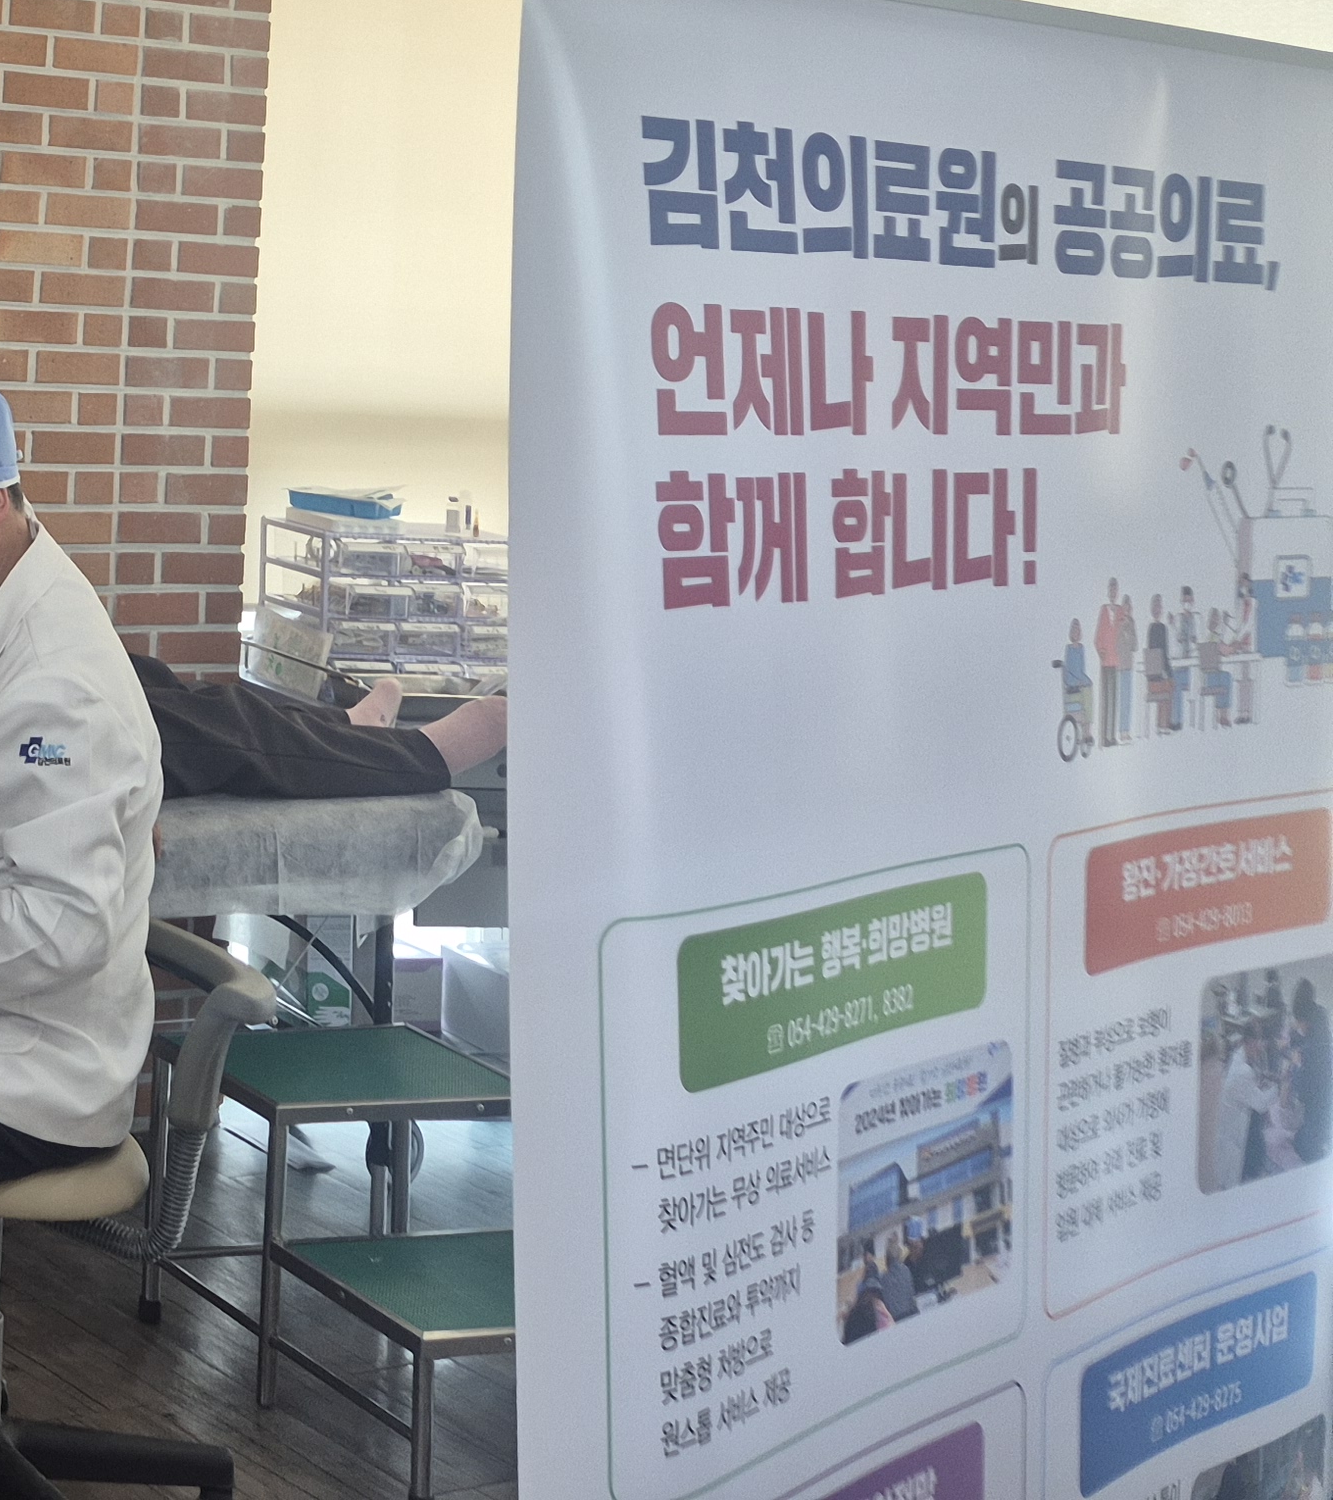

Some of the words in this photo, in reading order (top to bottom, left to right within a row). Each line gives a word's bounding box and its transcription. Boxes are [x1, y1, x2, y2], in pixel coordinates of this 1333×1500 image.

[641, 115, 1039, 268] 김천의료원의
[1054, 159, 1280, 291] 공공의료,
[650, 301, 873, 436] 언제나
[892, 313, 1126, 436] 지역민과
[656, 470, 809, 609] 함께
[832, 467, 1037, 599] 합니다!
[28, 743, 66, 758] GMC
[721, 940, 815, 1007] 찾아가는
[821, 902, 953, 979] 행복·희망병원
[883, 983, 914, 1017] 8382
[657, 1135, 711, 1180] 면단위
[717, 1114, 774, 1162] 지역주민
[779, 1096, 831, 1139] 대상으로
[658, 1185, 727, 1234] 찾아가는
[731, 1169, 761, 1210] 무상
[766, 1146, 831, 1194] 의료서비스
[659, 1255, 696, 1298] 혈액
[702, 1248, 717, 1285] 및
[722, 1232, 766, 1277] 심전도
[770, 1215, 798, 1257] 검사
[802, 1209, 815, 1243] 등
[659, 1290, 742, 1351] 종합진료와
[1217, 1302, 1289, 1365] 운영사업
[660, 1353, 712, 1405] 맞춤형
